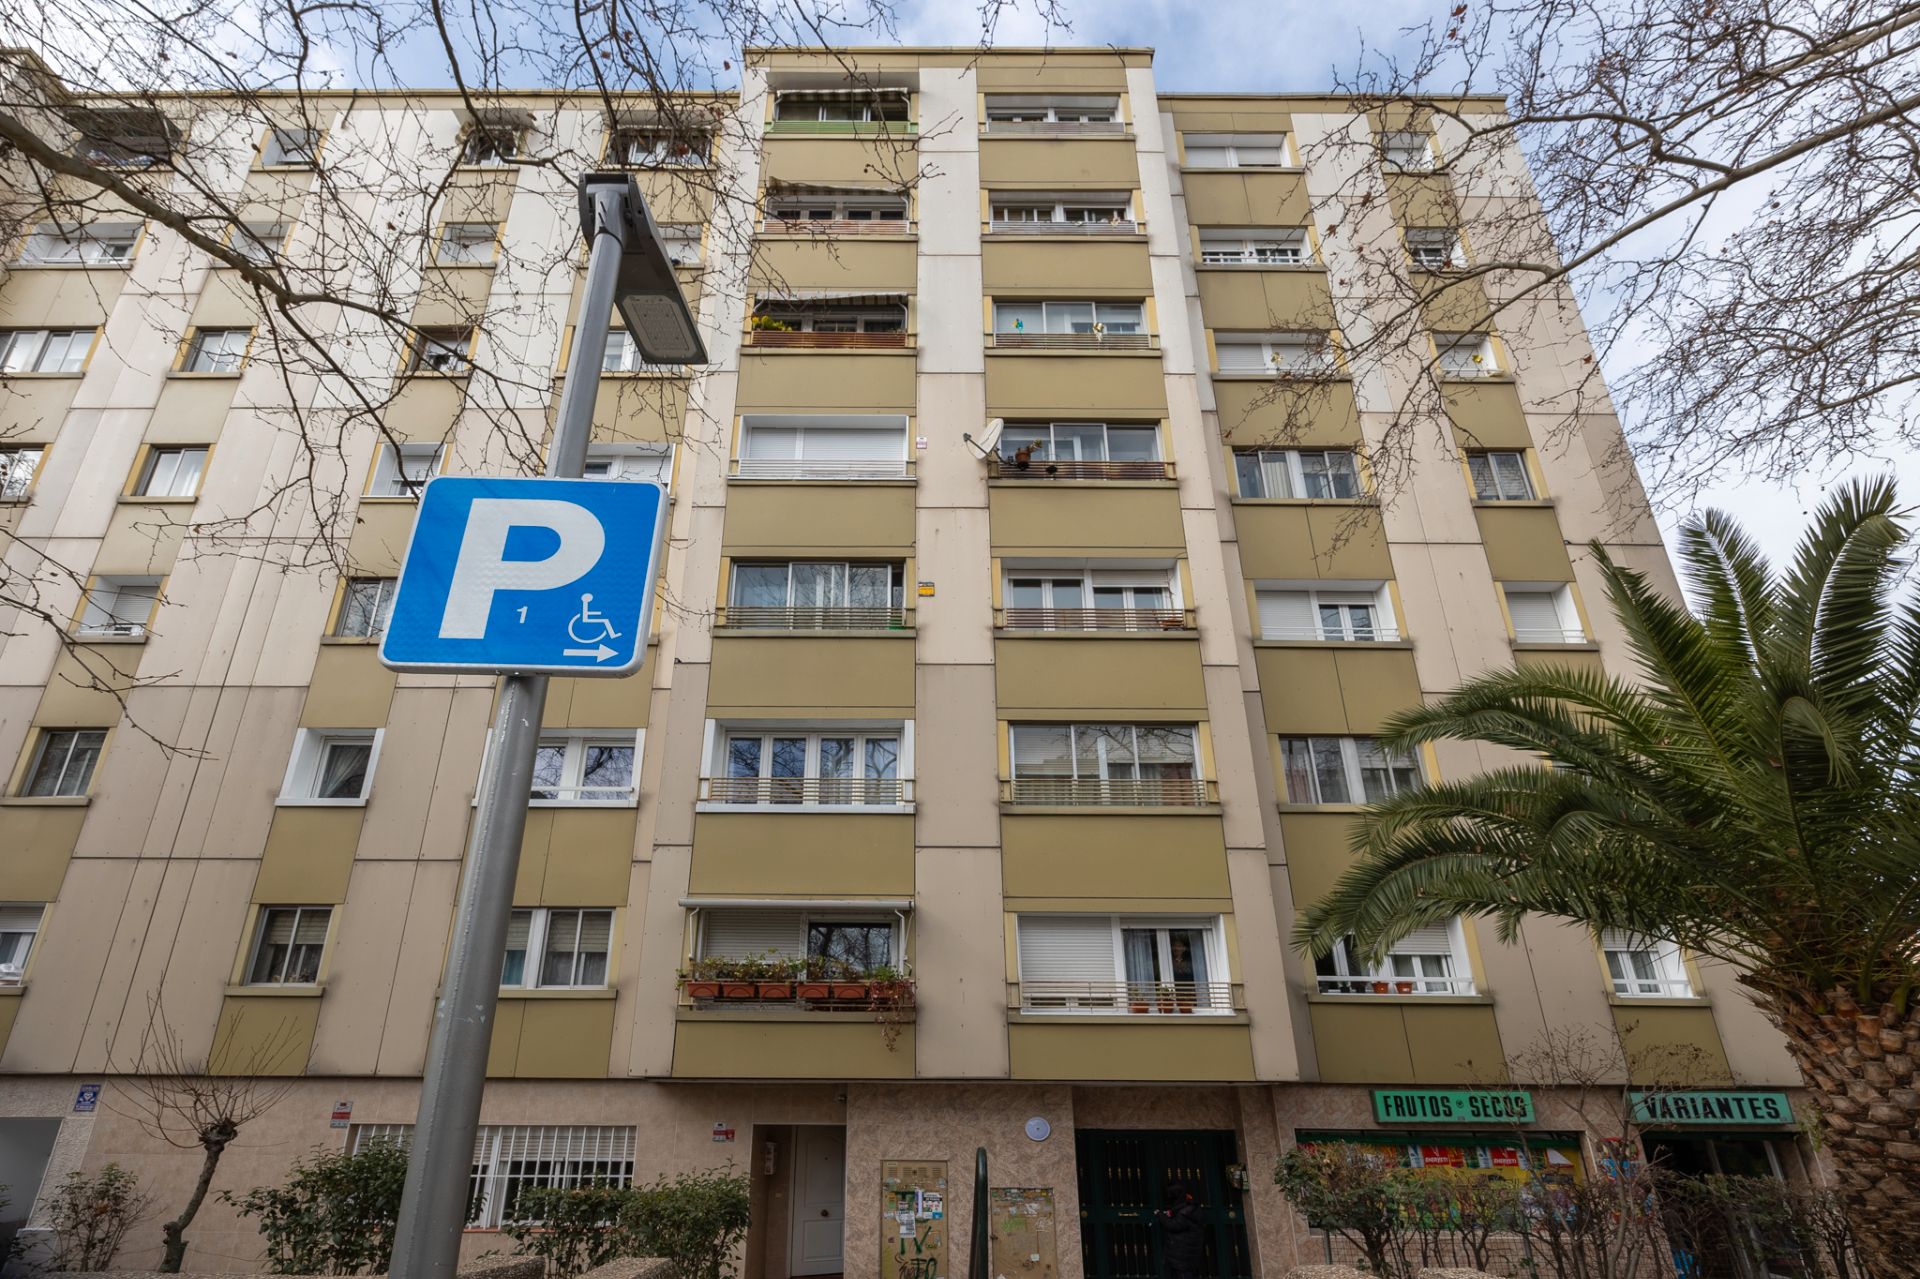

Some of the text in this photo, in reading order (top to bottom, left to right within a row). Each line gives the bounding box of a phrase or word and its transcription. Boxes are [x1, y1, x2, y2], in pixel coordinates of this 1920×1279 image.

[438, 498, 606, 639] P
[516, 606, 528, 624] 1
[1382, 1095, 1528, 1118] FRUTOS SECOS
[1644, 1096, 1781, 1120] VARIANTES
